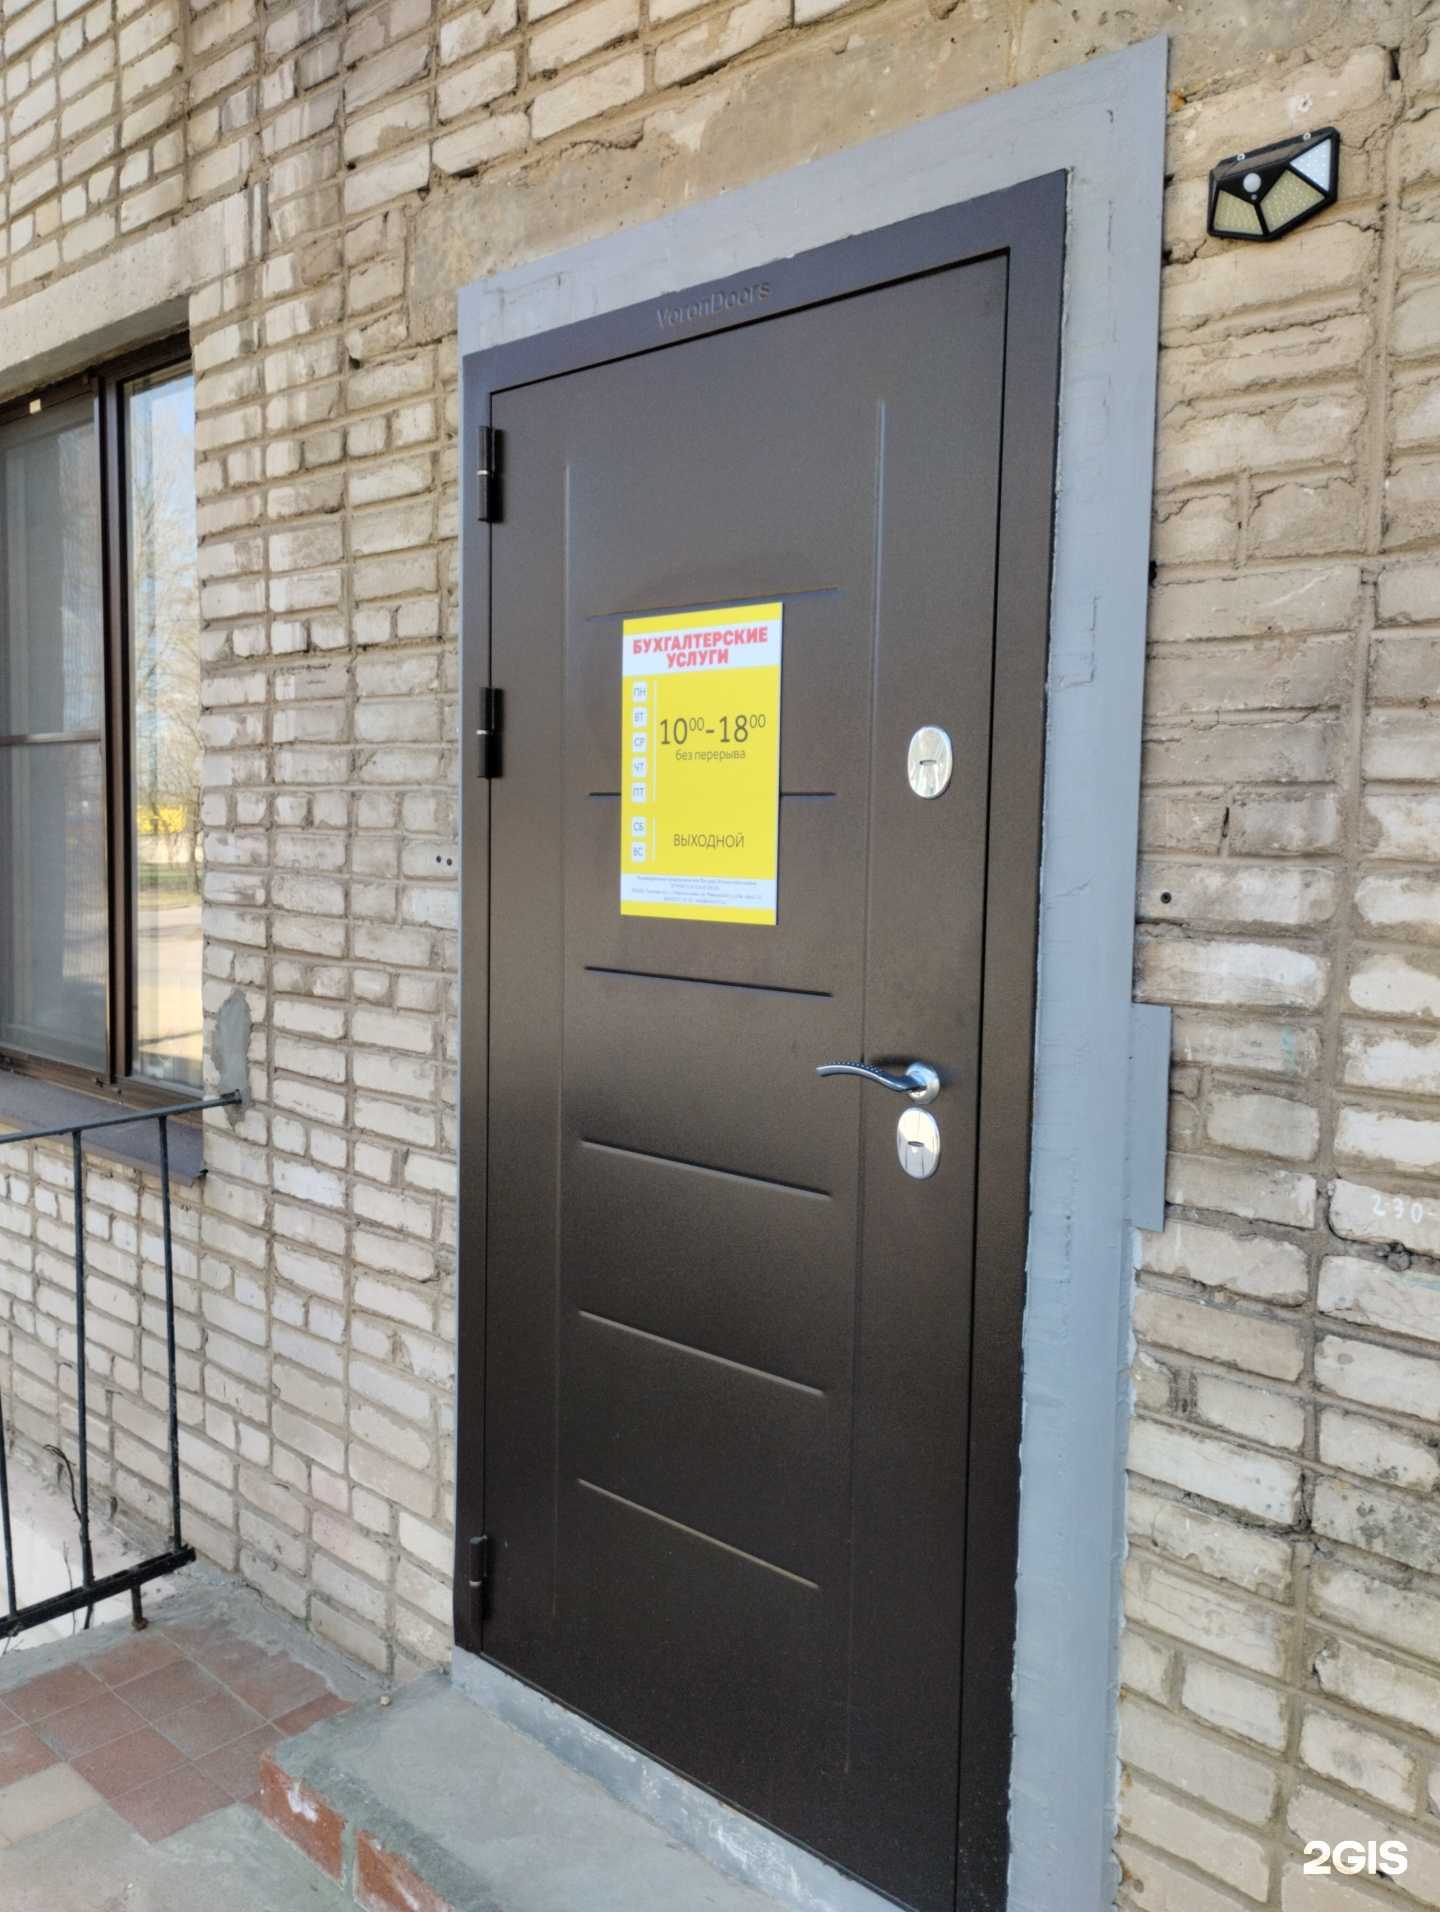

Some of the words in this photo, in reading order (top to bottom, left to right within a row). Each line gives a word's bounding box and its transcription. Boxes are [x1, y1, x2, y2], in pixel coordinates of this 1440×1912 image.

[657, 282, 770, 329] VoronDoors
[632, 627, 769, 654] БУХГАЛТЕРСКИЕ
[666, 649, 729, 668] УСЛУГИ
[633, 687, 646, 697] ПН
[634, 712, 644, 722] ВТ
[633, 737, 645, 747] СР
[675, 749, 692, 761] без
[694, 750, 746, 763] перерыва
[633, 762, 645, 771] ЧТ
[632, 787, 645, 797] ПТ
[632, 822, 644, 831] СБ
[673, 832, 745, 849] ВЫХОДНОЙ
